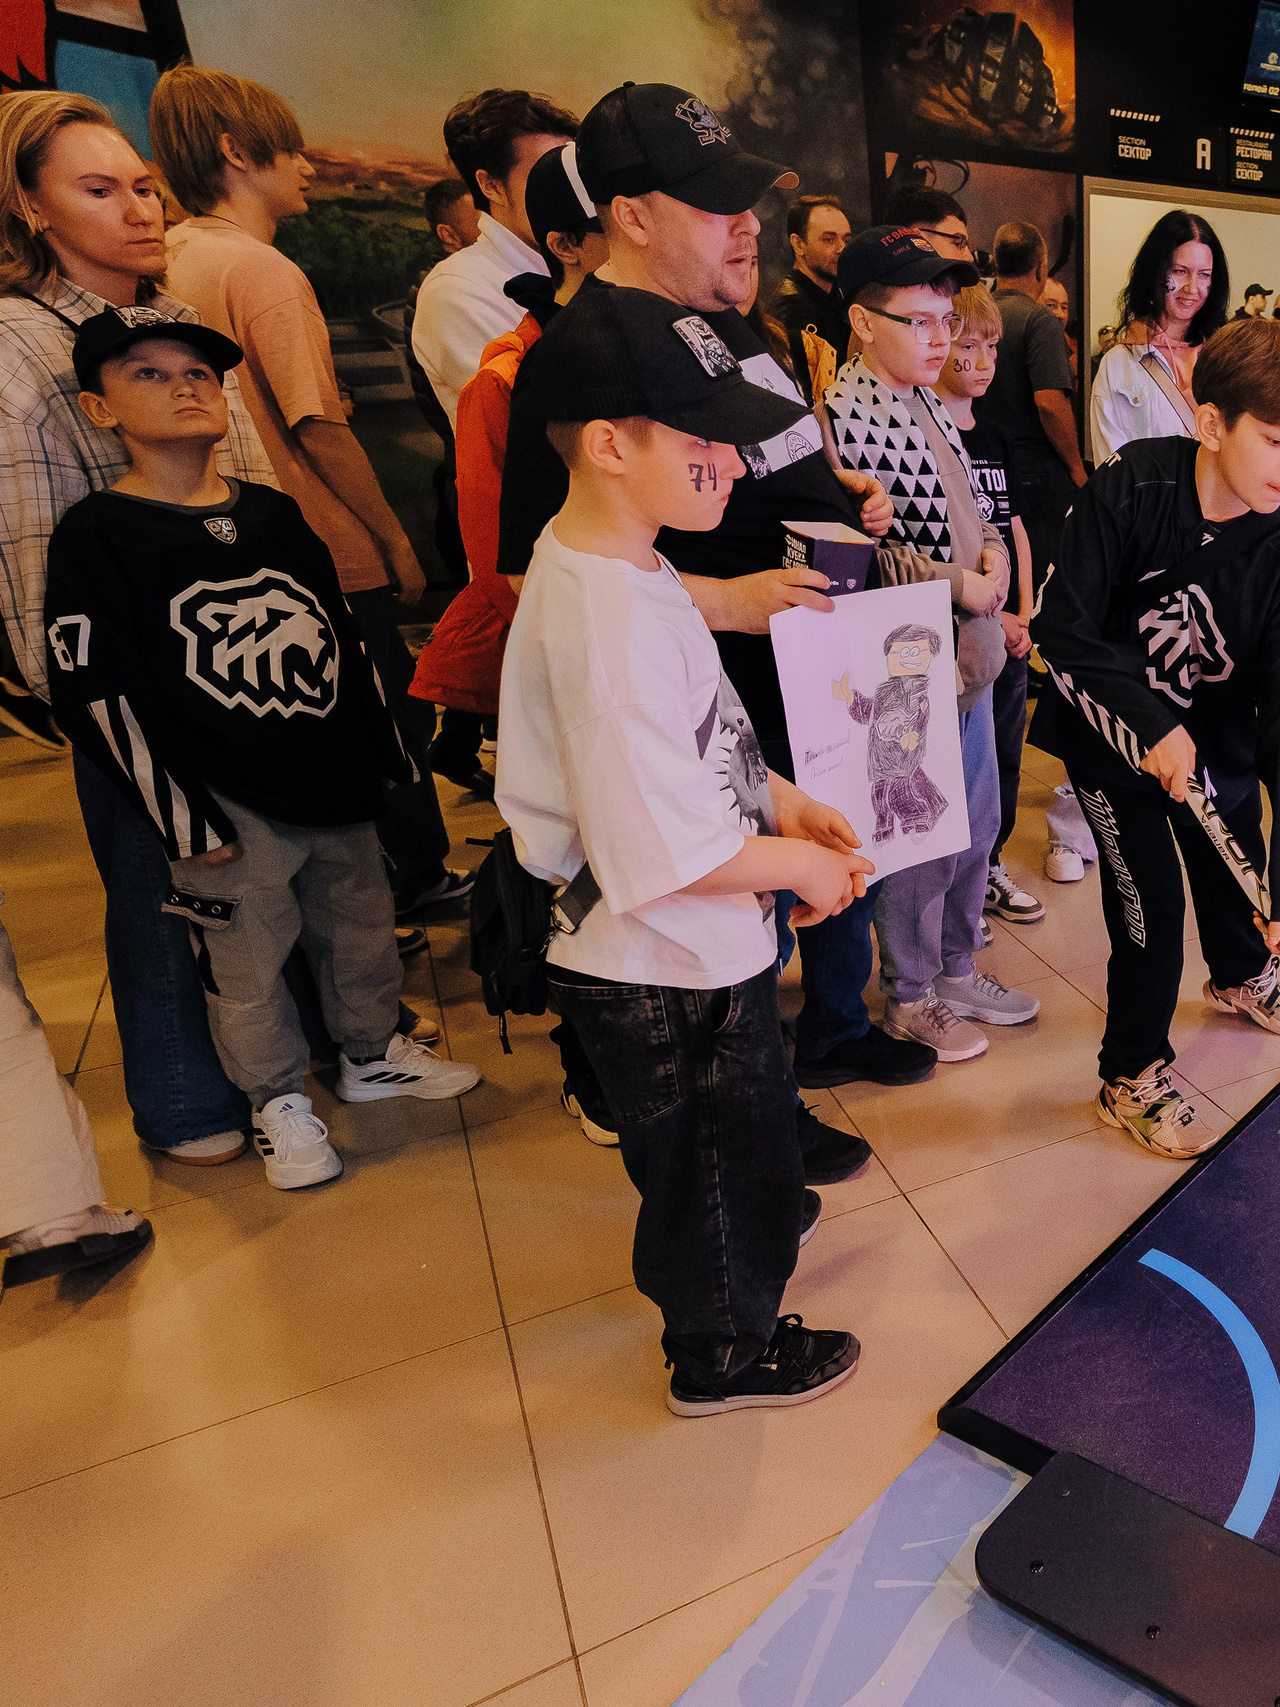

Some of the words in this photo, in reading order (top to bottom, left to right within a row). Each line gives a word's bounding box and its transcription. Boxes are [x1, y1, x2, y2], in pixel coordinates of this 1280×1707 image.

[1118, 135, 1146, 146] SECTION
[1118, 144, 1152, 161] СЕКТОР
[1235, 146, 1273, 161] РЕСТОРАН
[1235, 168, 1264, 182] СЕКТОР
[953, 358, 972, 373] 30
[688, 462, 717, 493] 74
[48, 614, 91, 671] 87
